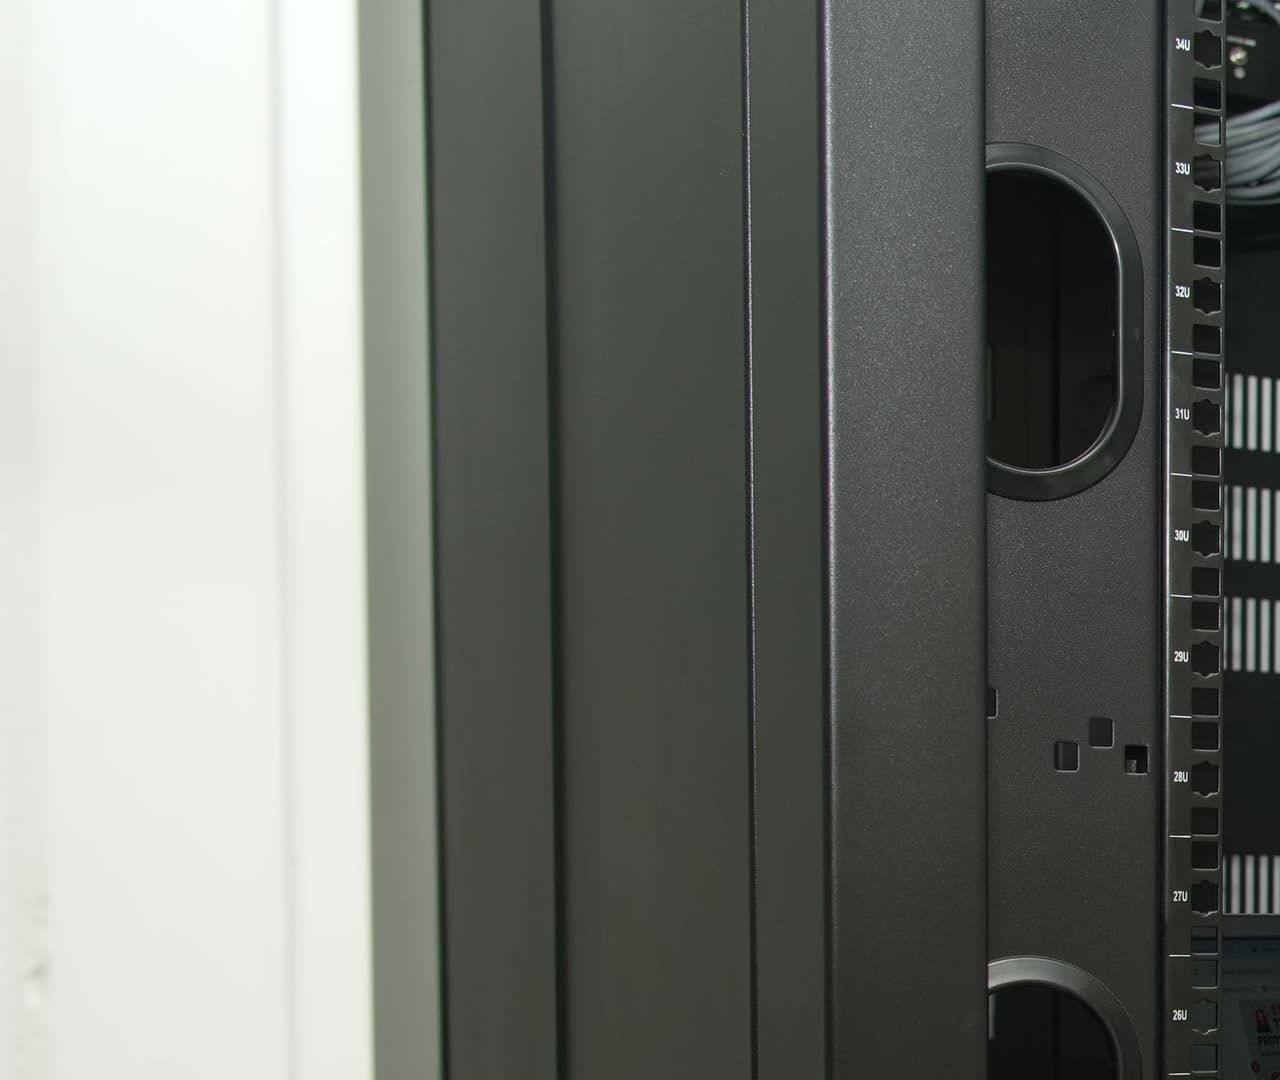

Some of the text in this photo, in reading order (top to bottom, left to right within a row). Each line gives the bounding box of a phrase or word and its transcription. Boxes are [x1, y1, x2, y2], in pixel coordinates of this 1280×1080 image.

[1176, 37, 1190, 51] 34U
[1176, 162, 1190, 175] 33U
[1175, 286, 1190, 298] 32U
[1175, 408, 1189, 420] 31U
[1174, 529, 1189, 542] 30U
[1174, 650, 1188, 662] 29U
[1174, 771, 1188, 782] 28U
[1174, 890, 1187, 901] 27U
[1173, 1009, 1187, 1020] 26U
